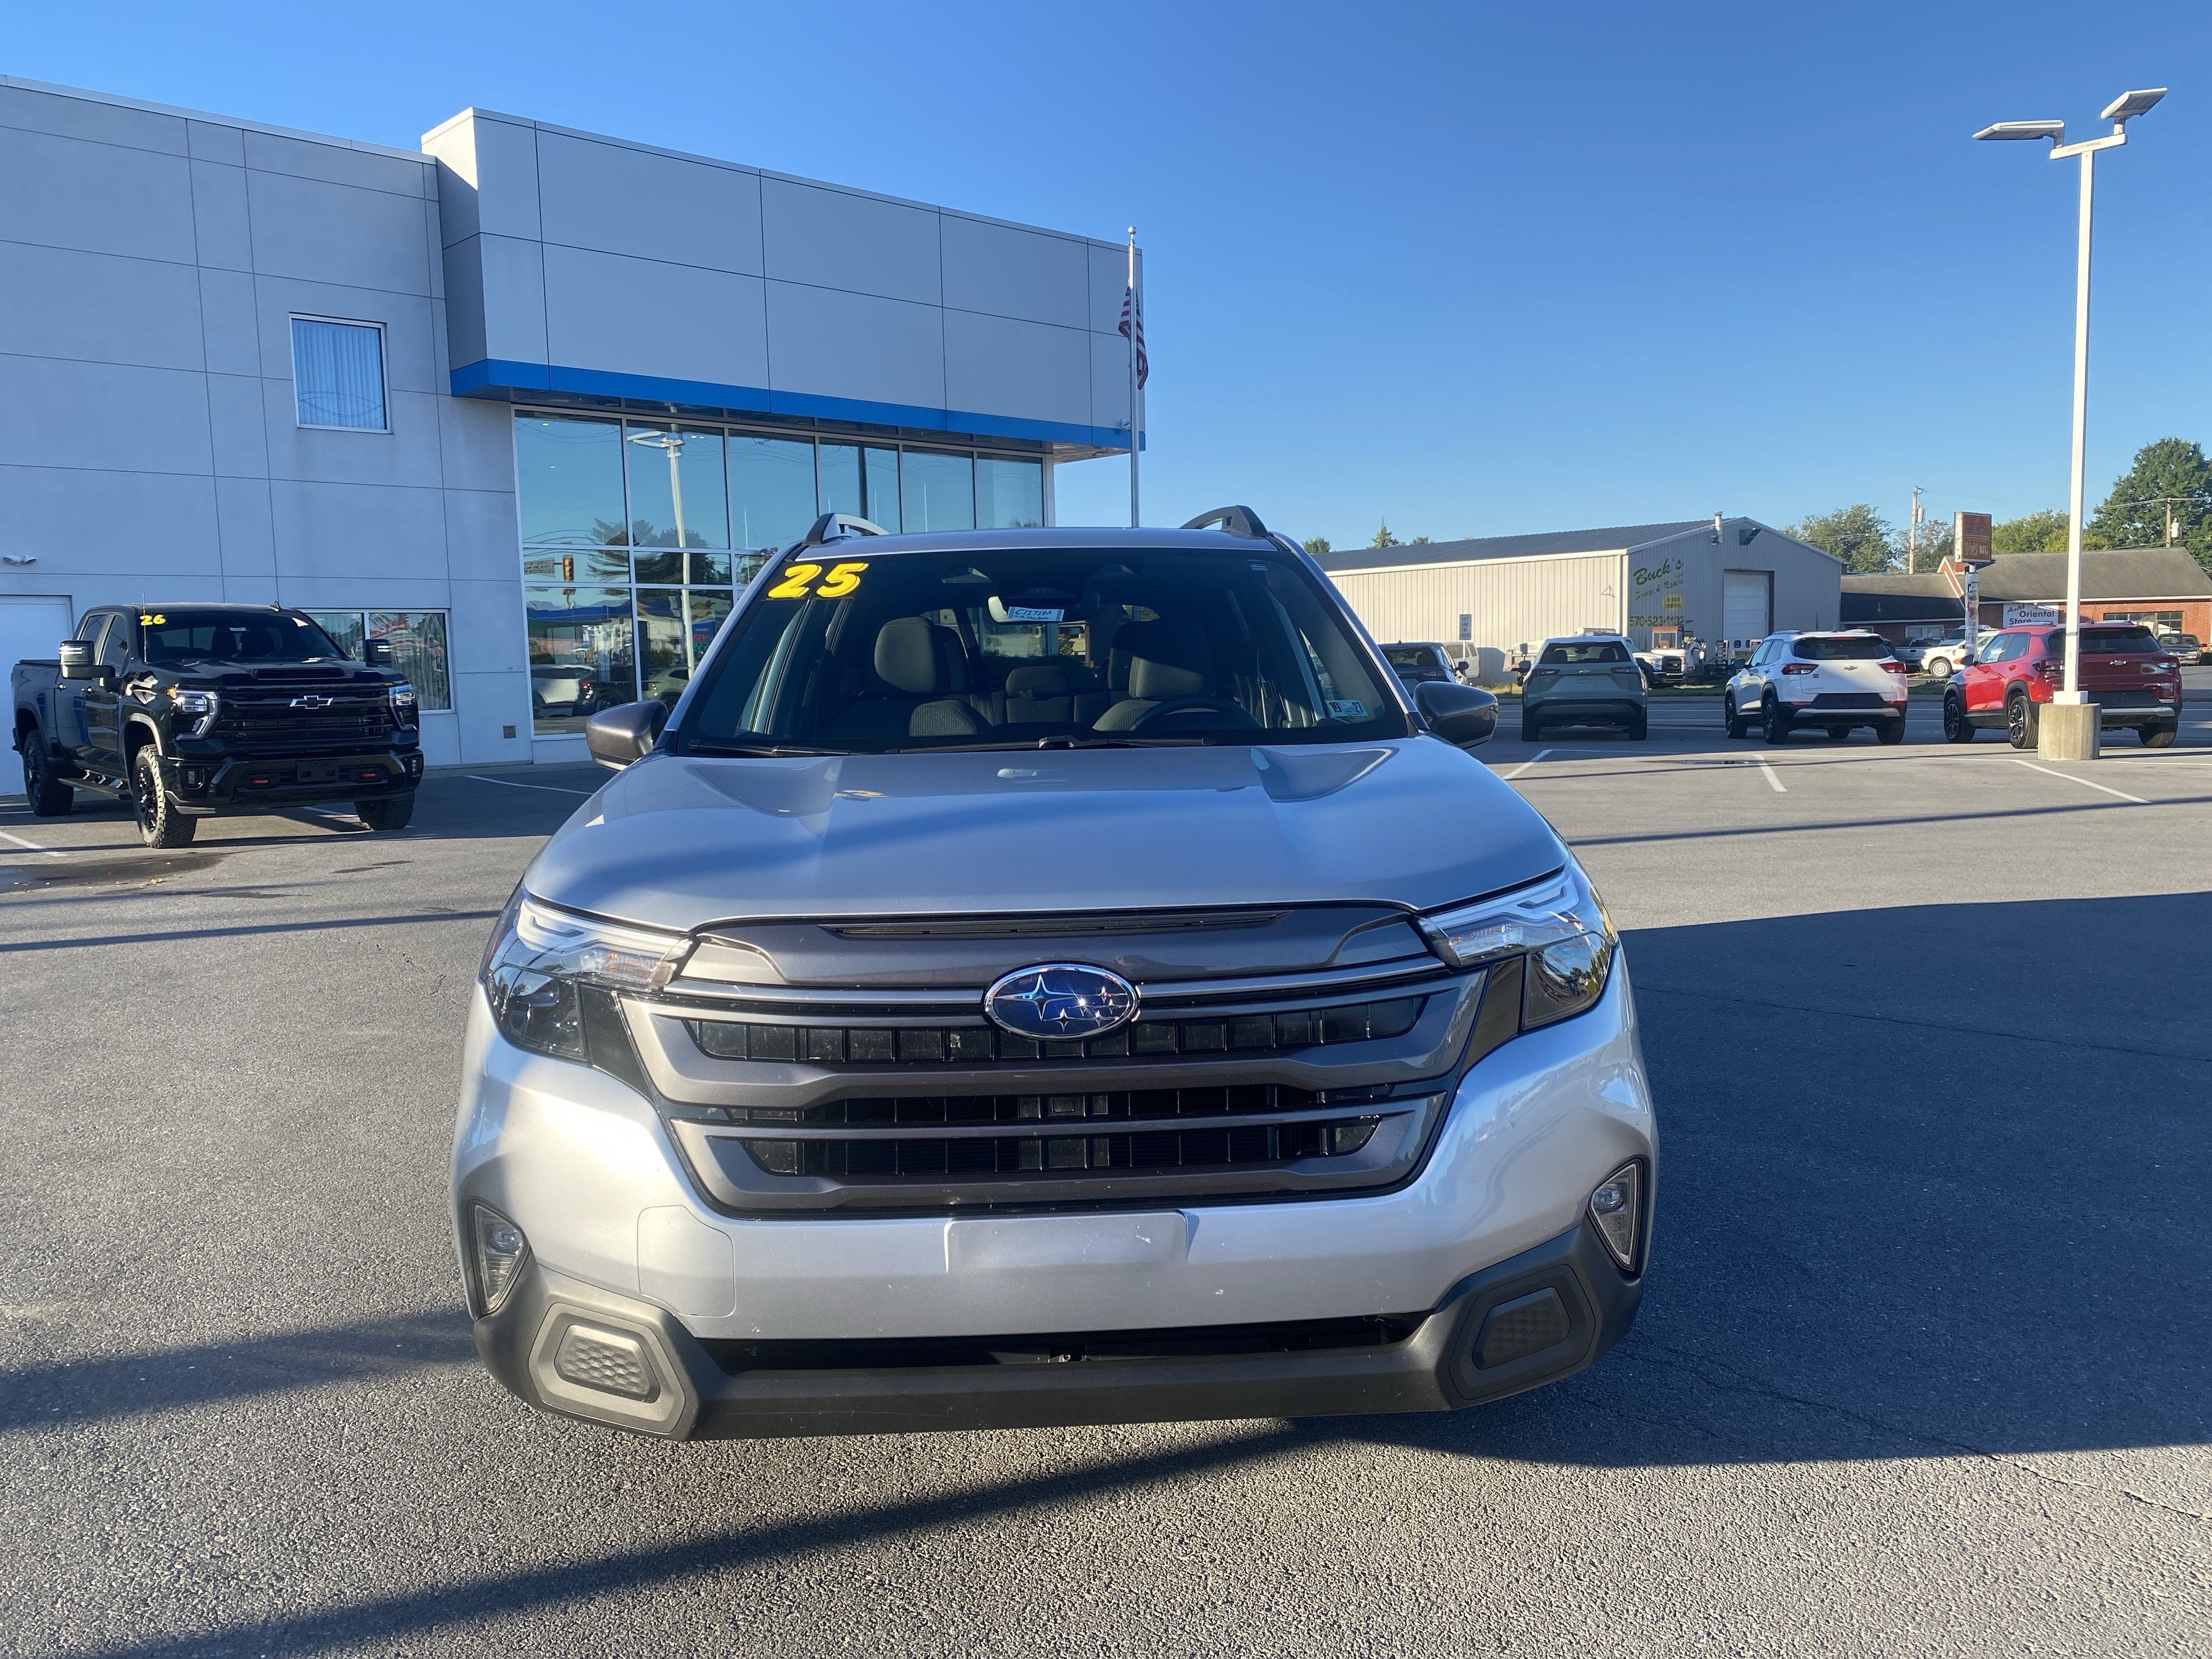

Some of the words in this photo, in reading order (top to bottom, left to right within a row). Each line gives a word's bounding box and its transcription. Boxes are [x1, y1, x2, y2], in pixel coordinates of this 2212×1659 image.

[768, 562, 869, 598] 25
[1633, 557, 1684, 585] Buck's
[140, 614, 166, 626] 26
[1328, 702, 1342, 713] 10
